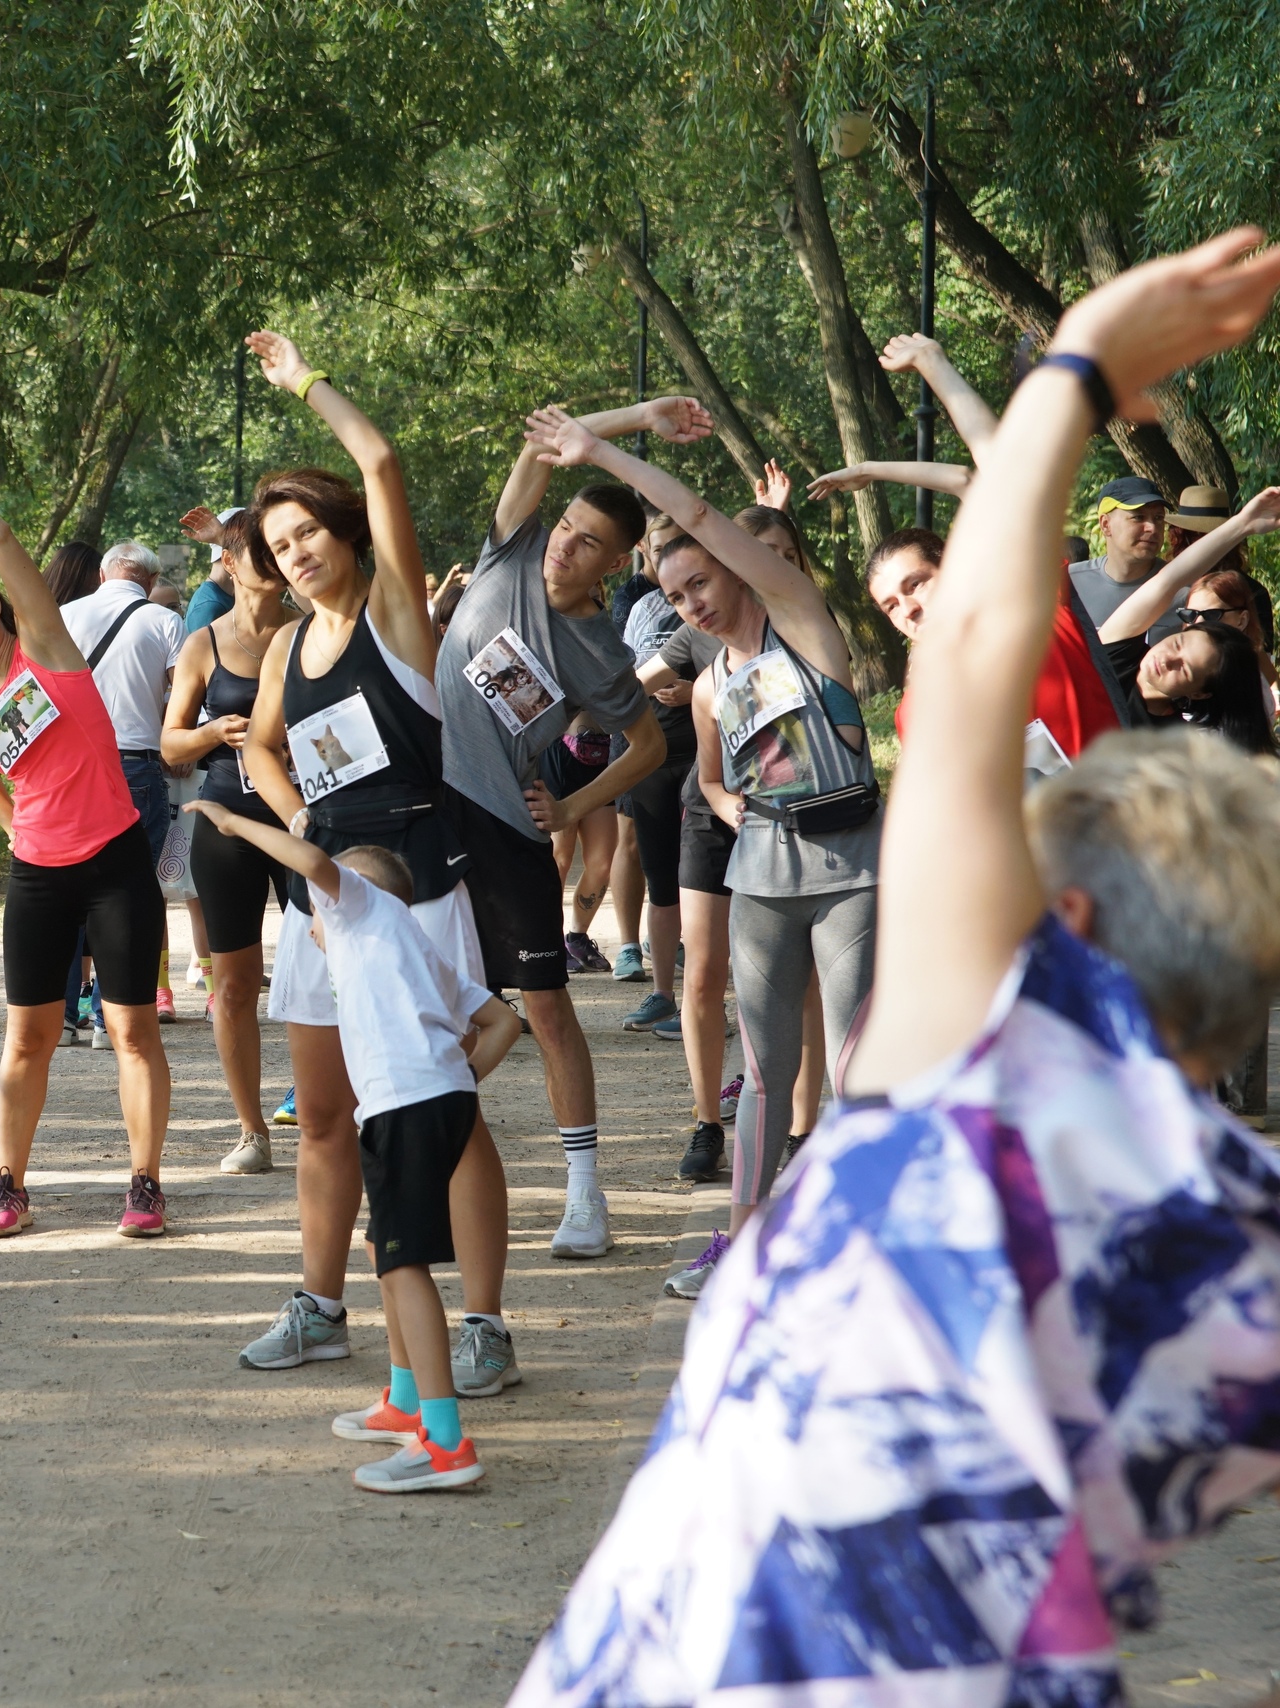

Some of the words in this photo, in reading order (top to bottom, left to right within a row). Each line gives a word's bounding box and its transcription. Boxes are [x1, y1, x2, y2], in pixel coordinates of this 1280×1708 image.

[728, 713, 757, 750] 097
[0, 733, 28, 769] 054
[304, 766, 343, 799] 041
